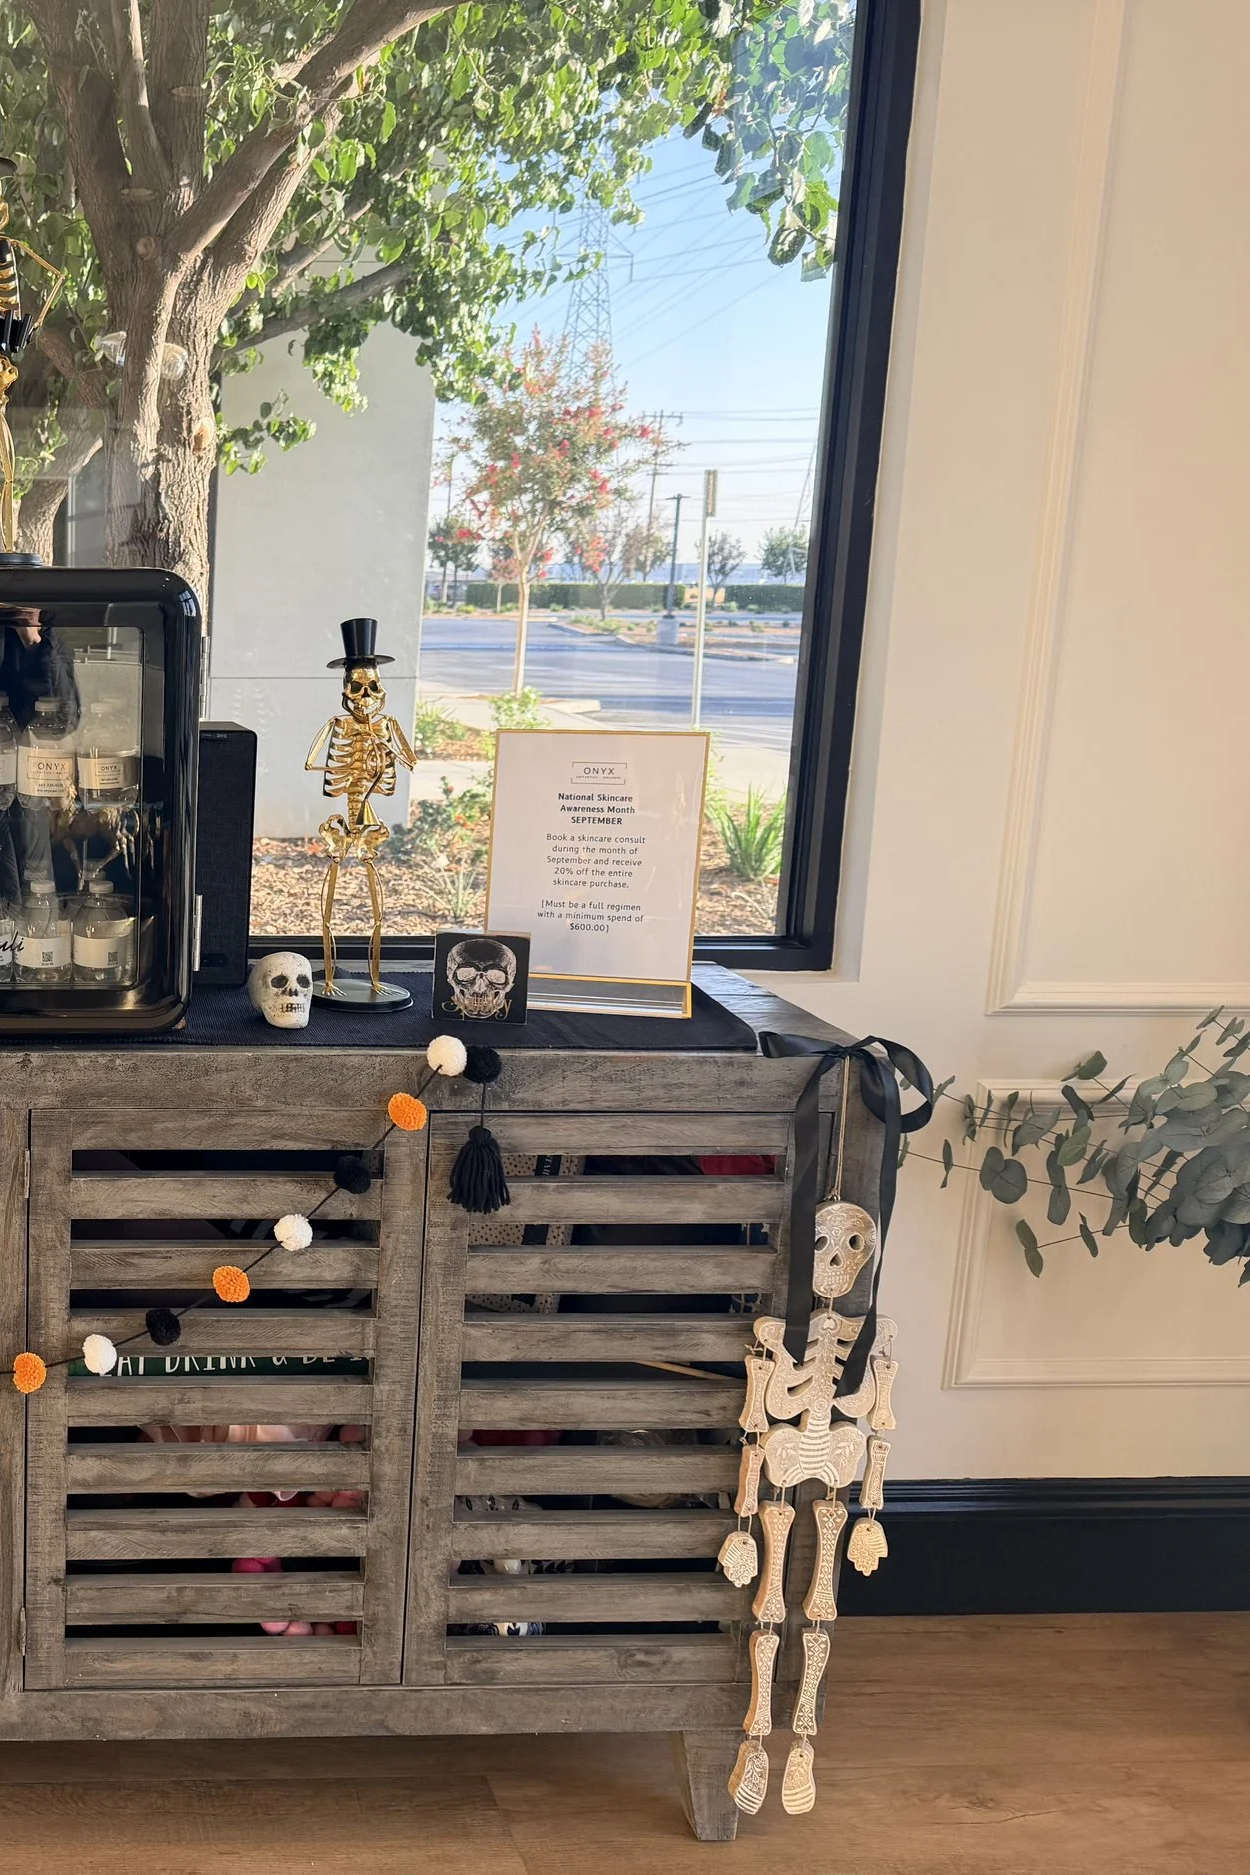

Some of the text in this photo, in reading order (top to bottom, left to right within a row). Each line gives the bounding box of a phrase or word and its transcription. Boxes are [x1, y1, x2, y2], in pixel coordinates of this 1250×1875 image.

[37, 762, 66, 771] ONYX
[583, 767, 615, 775] ONYX
[558, 793, 633, 802] National Skincare
[560, 804, 635, 814] Awareness Month
[571, 816, 623, 825] SEPTEMBER
[546, 833, 567, 841] Book
[577, 834, 612, 842] skincare
[614, 836, 646, 844] consult
[552, 845, 579, 854] during
[547, 855, 591, 865] September
[554, 867, 573, 875] 20%
[608, 870, 633, 878] entire
[553, 878, 629, 888] skincare purchase.
[569, 900, 579, 909] be
[589, 901, 604, 910] full
[606, 903, 641, 912] regimen
[565, 912, 604, 920] minimum
[607, 914, 632, 922] spend
[635, 914, 644, 923] of
